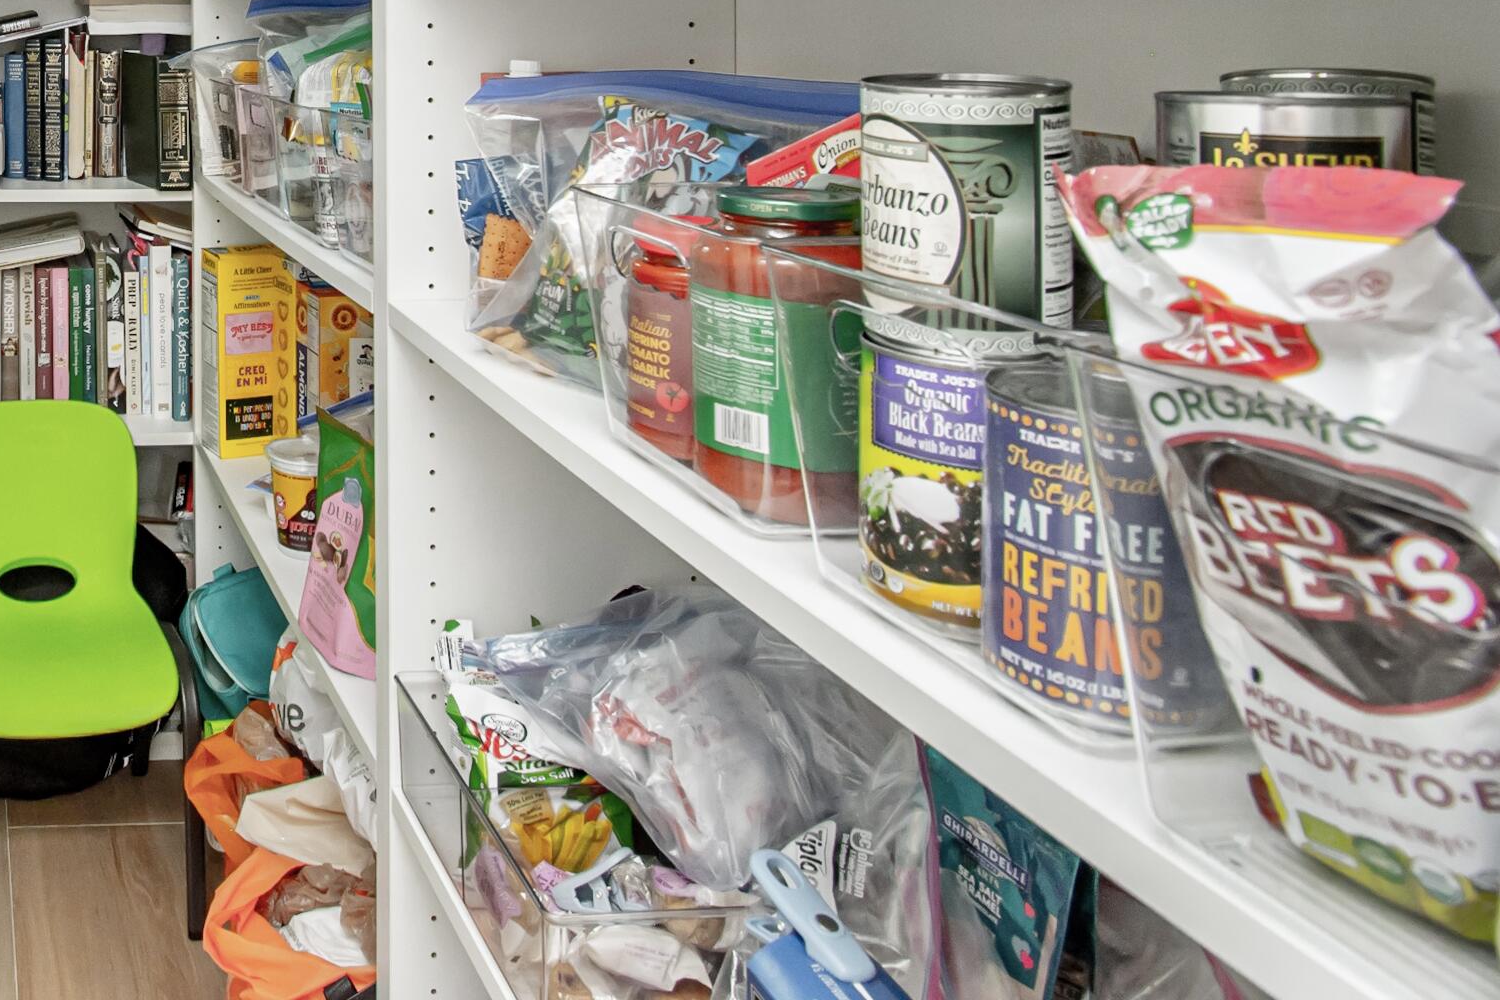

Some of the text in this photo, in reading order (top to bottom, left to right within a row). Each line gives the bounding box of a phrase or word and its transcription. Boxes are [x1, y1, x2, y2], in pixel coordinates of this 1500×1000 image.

[816, 136, 857, 169] Onion
[750, 204, 772, 213] OPEN
[862, 173, 949, 218] rbanzo
[863, 205, 922, 250] Beans
[240, 267, 255, 275] Little
[4, 274, 15, 334] JOY KOSHER
[23, 272, 33, 325] Eat Jewish
[128, 279, 137, 308] PREP
[233, 301, 271, 309] Affirmations
[84, 307, 94, 334] hungry
[128, 318, 137, 352] RALLY
[158, 293, 167, 368] peas love carrots
[176, 277, 190, 374] Quick & Kosher
[230, 323, 273, 338] MY BEST
[236, 378, 250, 387] EN
[239, 366, 265, 376] CREO
[298, 350, 307, 417] ALMOND
[632, 359, 671, 381] GARLIC
[895, 364, 977, 389] TRADER JOE'S
[904, 379, 971, 414] Organic
[889, 401, 986, 443] Black Beans
[1150, 383, 1385, 453] ORGANIC
[895, 430, 977, 460] Made with Sea Salt
[1019, 428, 1081, 454] TRADER
[1007, 443, 1160, 495] Traditinal
[1029, 478, 1102, 517] Style
[1217, 487, 1337, 546] RED
[1003, 491, 1164, 565] FAT FREE
[1003, 540, 1164, 623] REFRIED
[1188, 510, 1477, 627] BEETS
[931, 600, 952, 612] NET
[1003, 586, 1163, 681] BEANS
[1001, 646, 1019, 668] NET
[521, 768, 575, 784] Sea Salt
[943, 813, 1029, 887] GHIRARDELLI
[851, 846, 875, 898] Johnson
[958, 864, 1002, 904] SEA SALT
